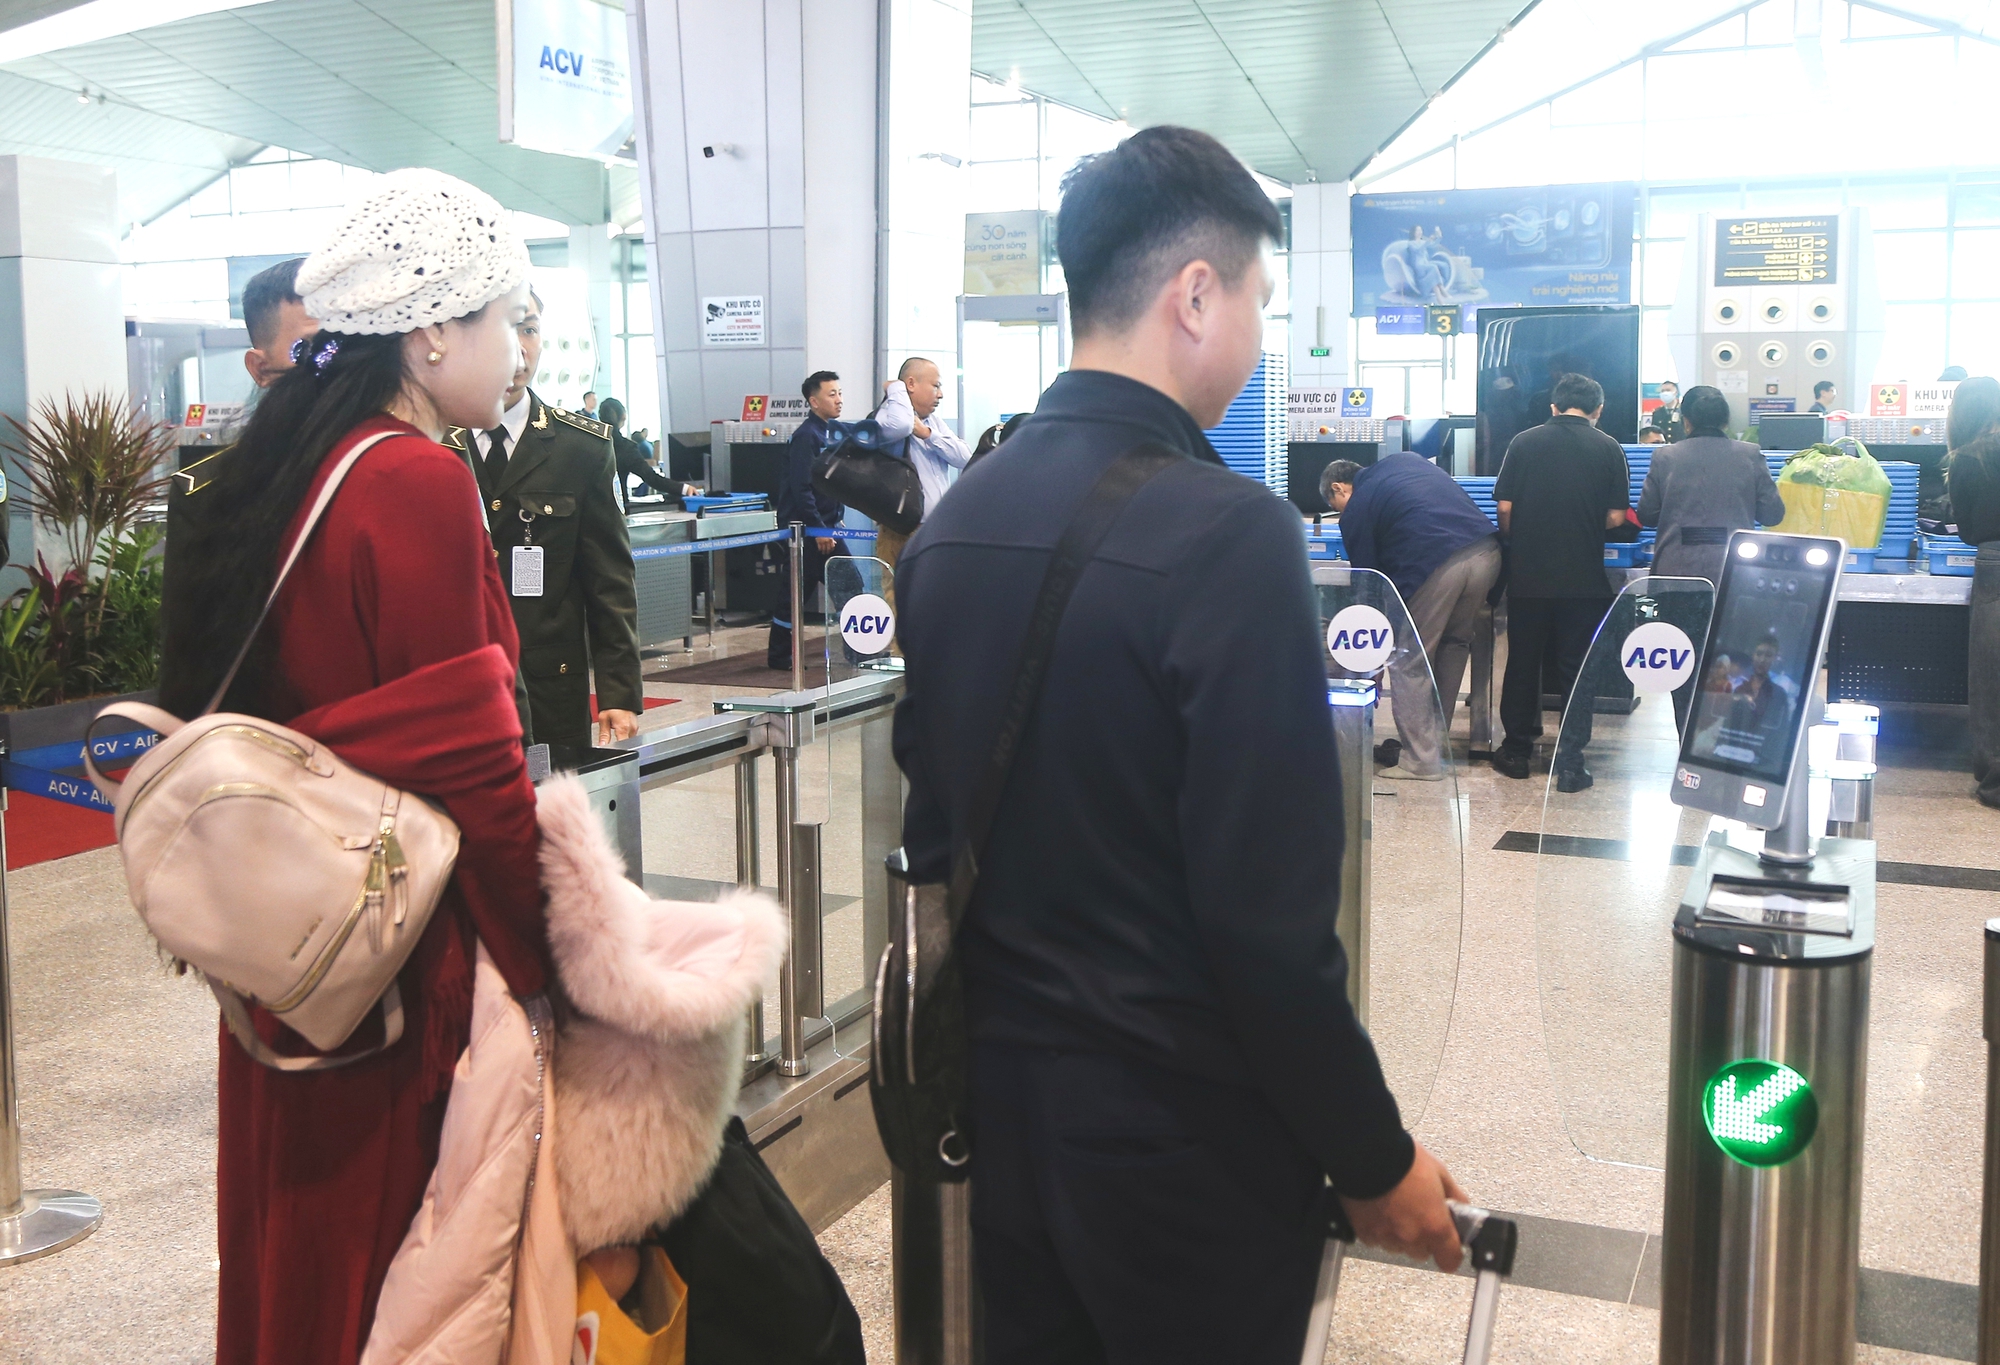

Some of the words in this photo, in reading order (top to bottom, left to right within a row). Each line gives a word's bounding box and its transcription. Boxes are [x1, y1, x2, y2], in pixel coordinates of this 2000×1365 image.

[540, 45, 583, 76] ACV
[981, 224, 1006, 241] 30
[726, 301, 738, 309] KHU
[1379, 315, 1401, 324] ACV
[1437, 315, 1452, 334] 3
[1288, 394, 1301, 403] HU
[1303, 392, 1322, 406] VỰC
[1324, 391, 1337, 403] CÓ
[1914, 390, 1938, 400] KHU
[771, 400, 787, 409] KHU
[788, 399, 803, 411] VỰC
[854, 531, 878, 539] AIRPO
[843, 615, 890, 635] ACV
[1331, 628, 1389, 650] ACV
[1625, 647, 1690, 671] ACV
[48, 779, 79, 798] ACV
[1684, 774, 1699, 787] ETC
